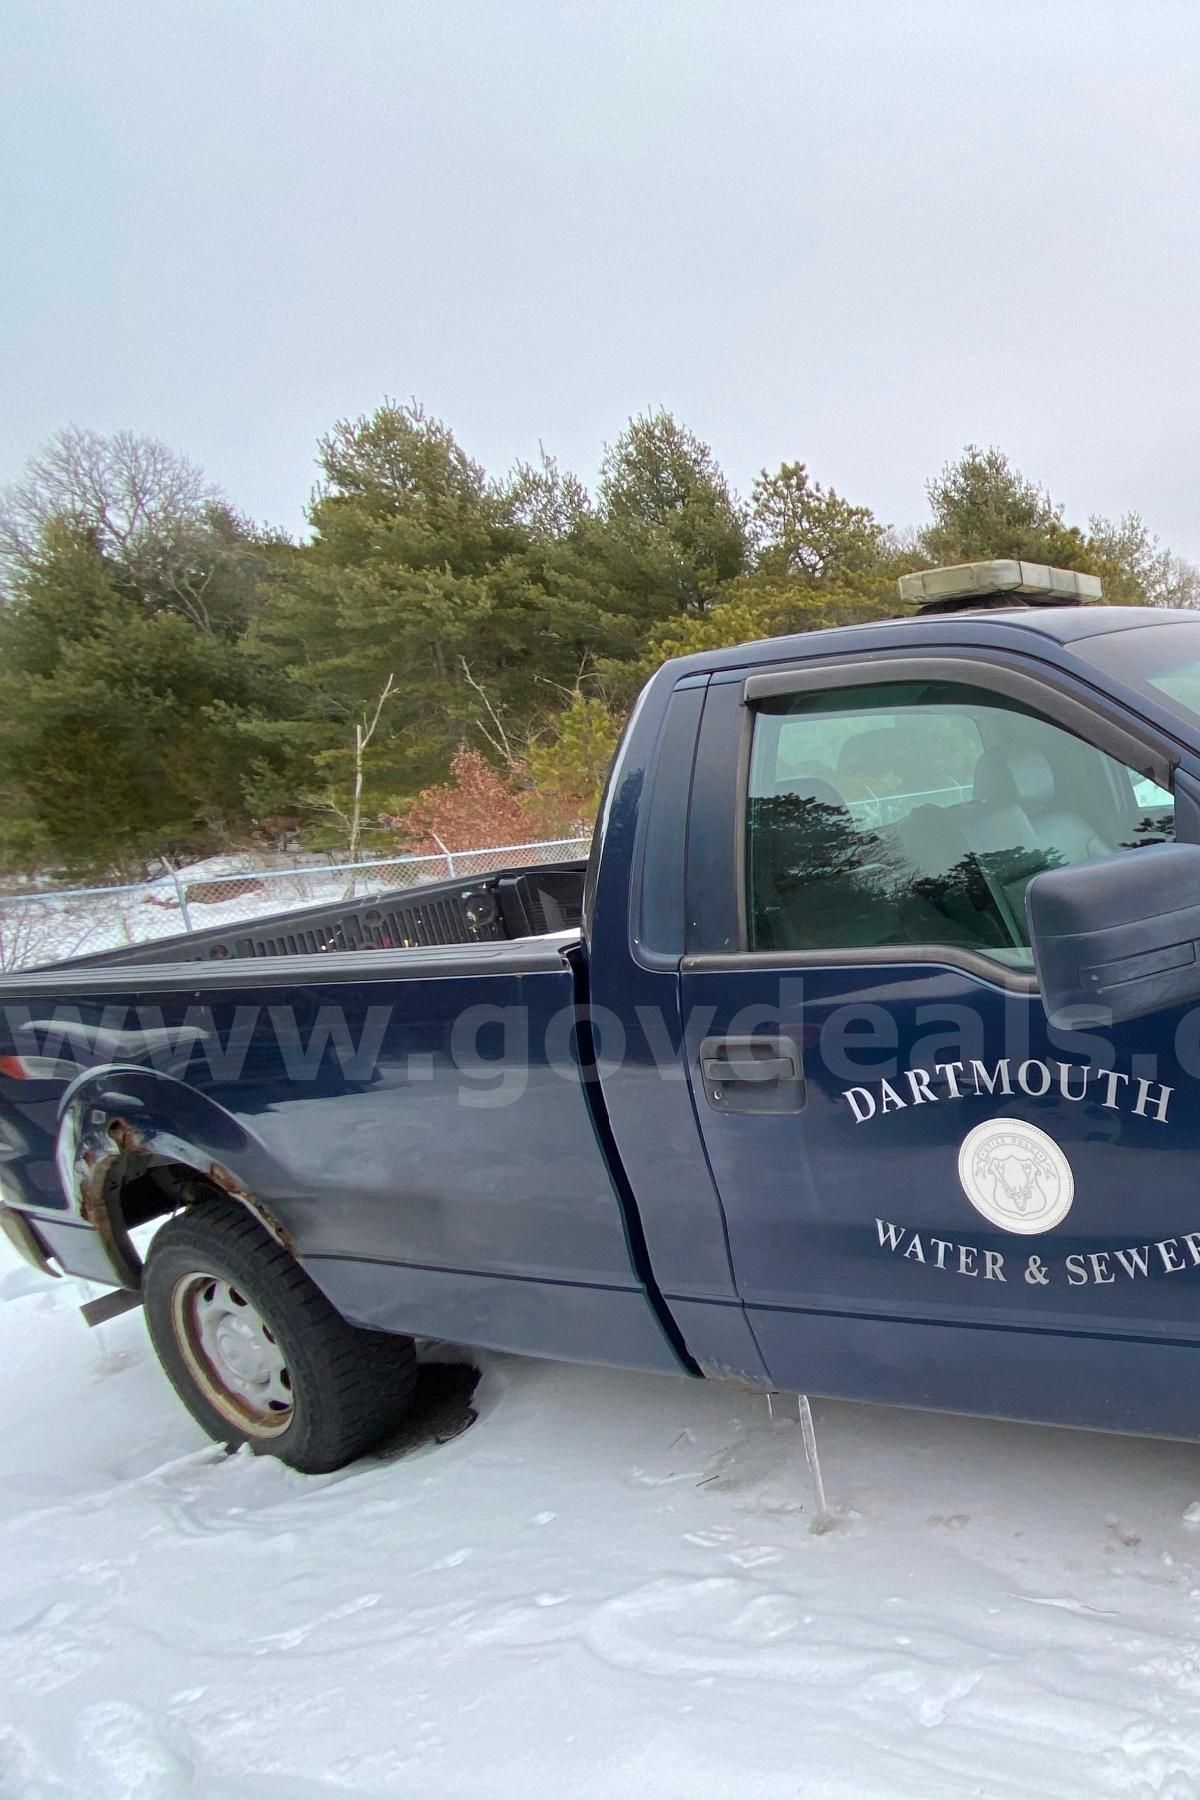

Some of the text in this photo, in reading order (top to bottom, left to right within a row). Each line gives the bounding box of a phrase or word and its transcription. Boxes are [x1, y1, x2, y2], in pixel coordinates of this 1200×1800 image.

[842, 1058, 1175, 1124] DARTMOUTH
[874, 1218, 1007, 1282] WATER
[1024, 1255, 1050, 1286] &
